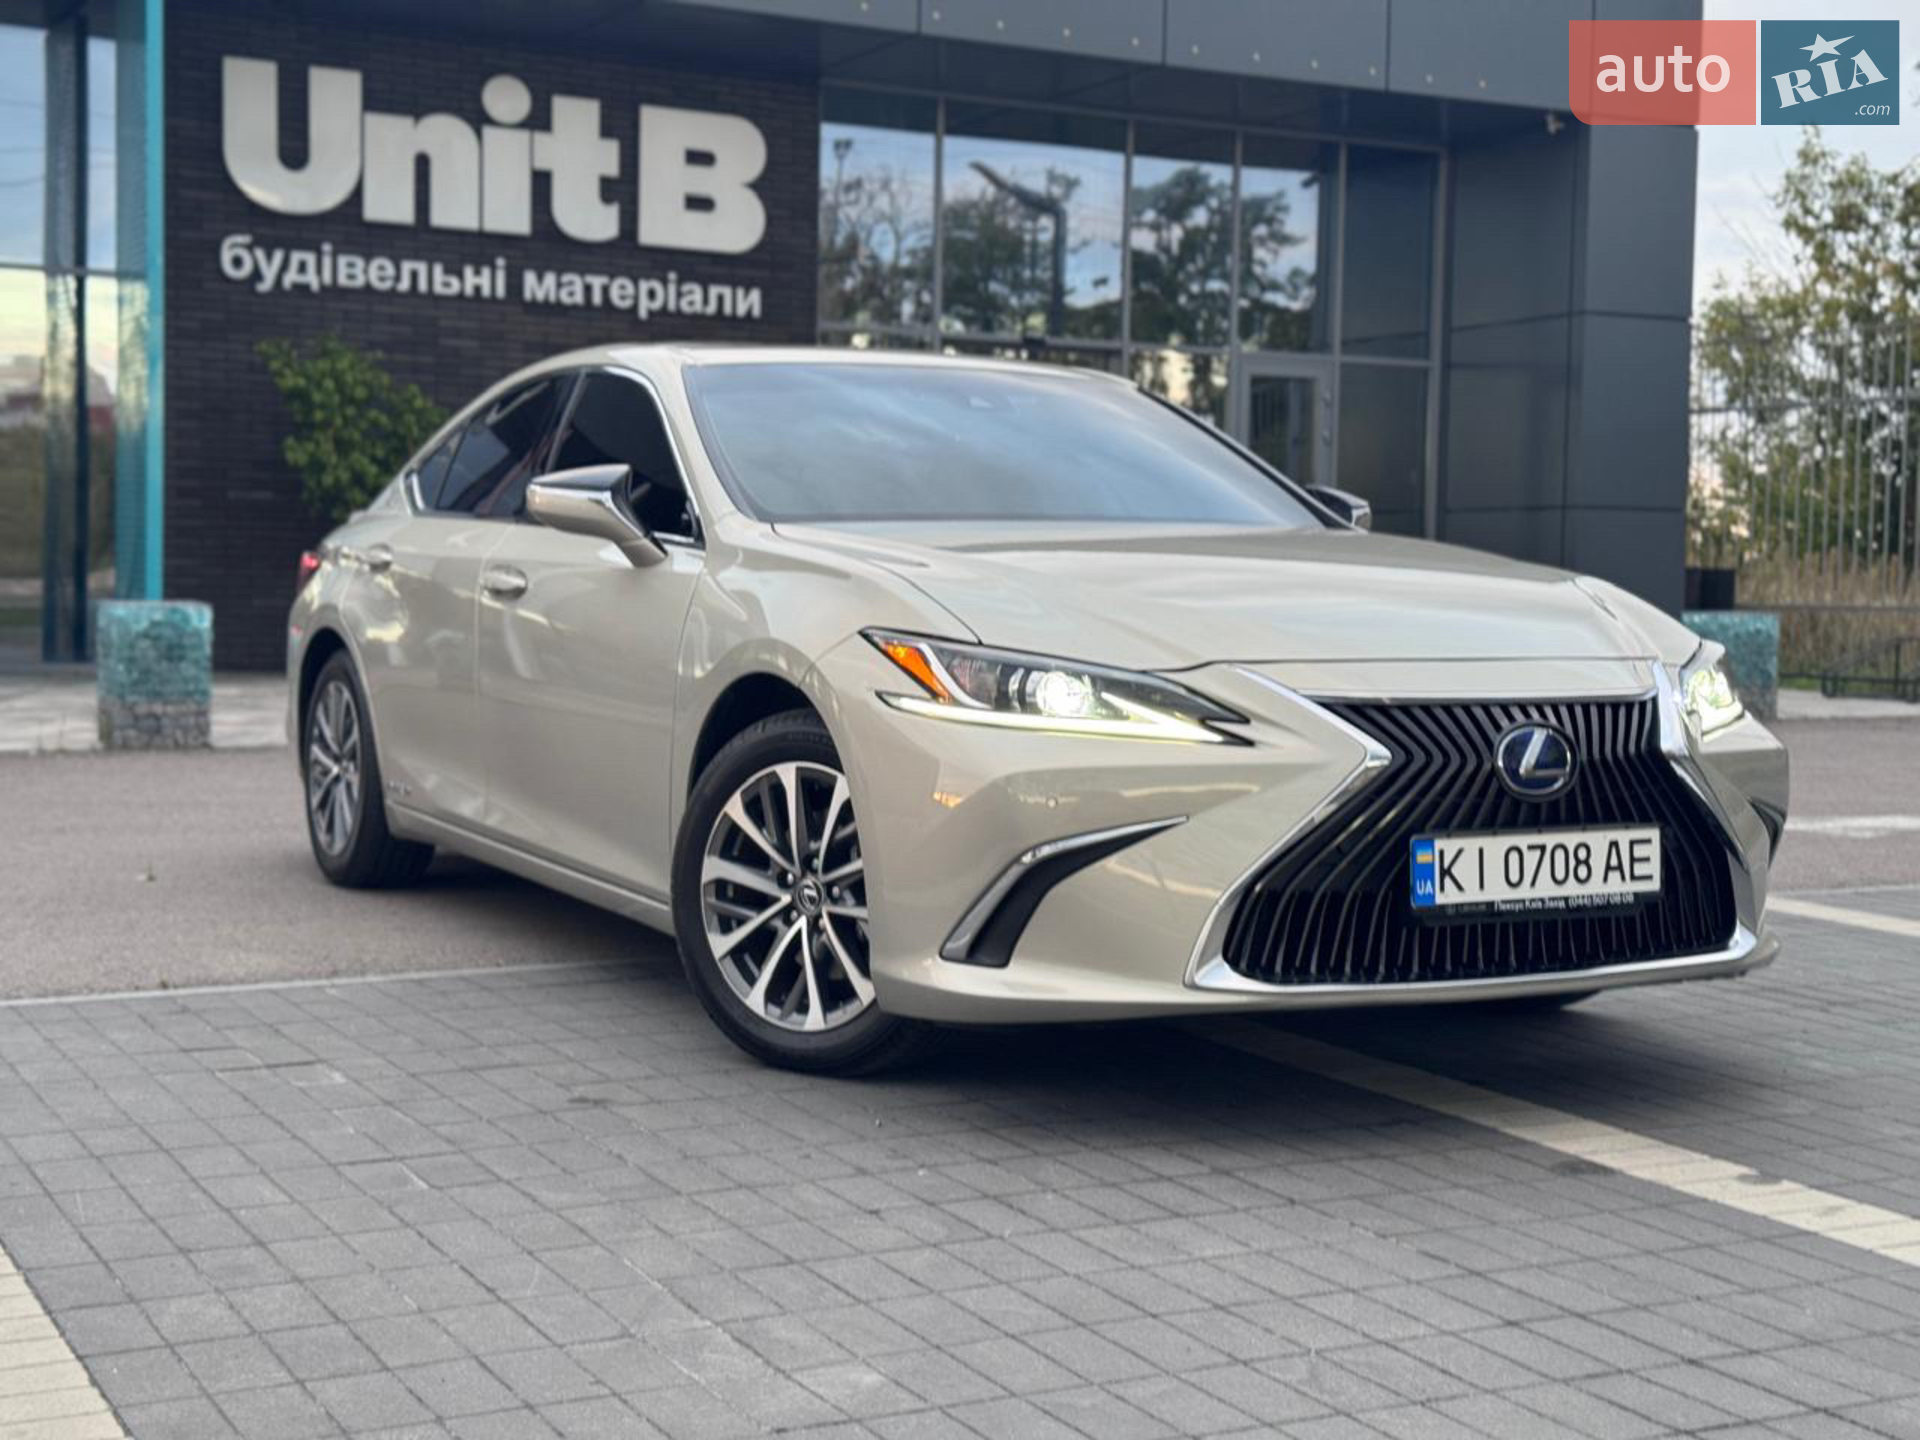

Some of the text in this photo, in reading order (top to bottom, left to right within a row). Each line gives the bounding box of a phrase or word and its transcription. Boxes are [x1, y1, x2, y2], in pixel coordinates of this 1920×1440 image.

[219, 235, 762, 319] будівельні матеріали
[1416, 879, 1434, 896] UA
[1504, 842, 1593, 889] 0708
[1603, 838, 1654, 884] AE
